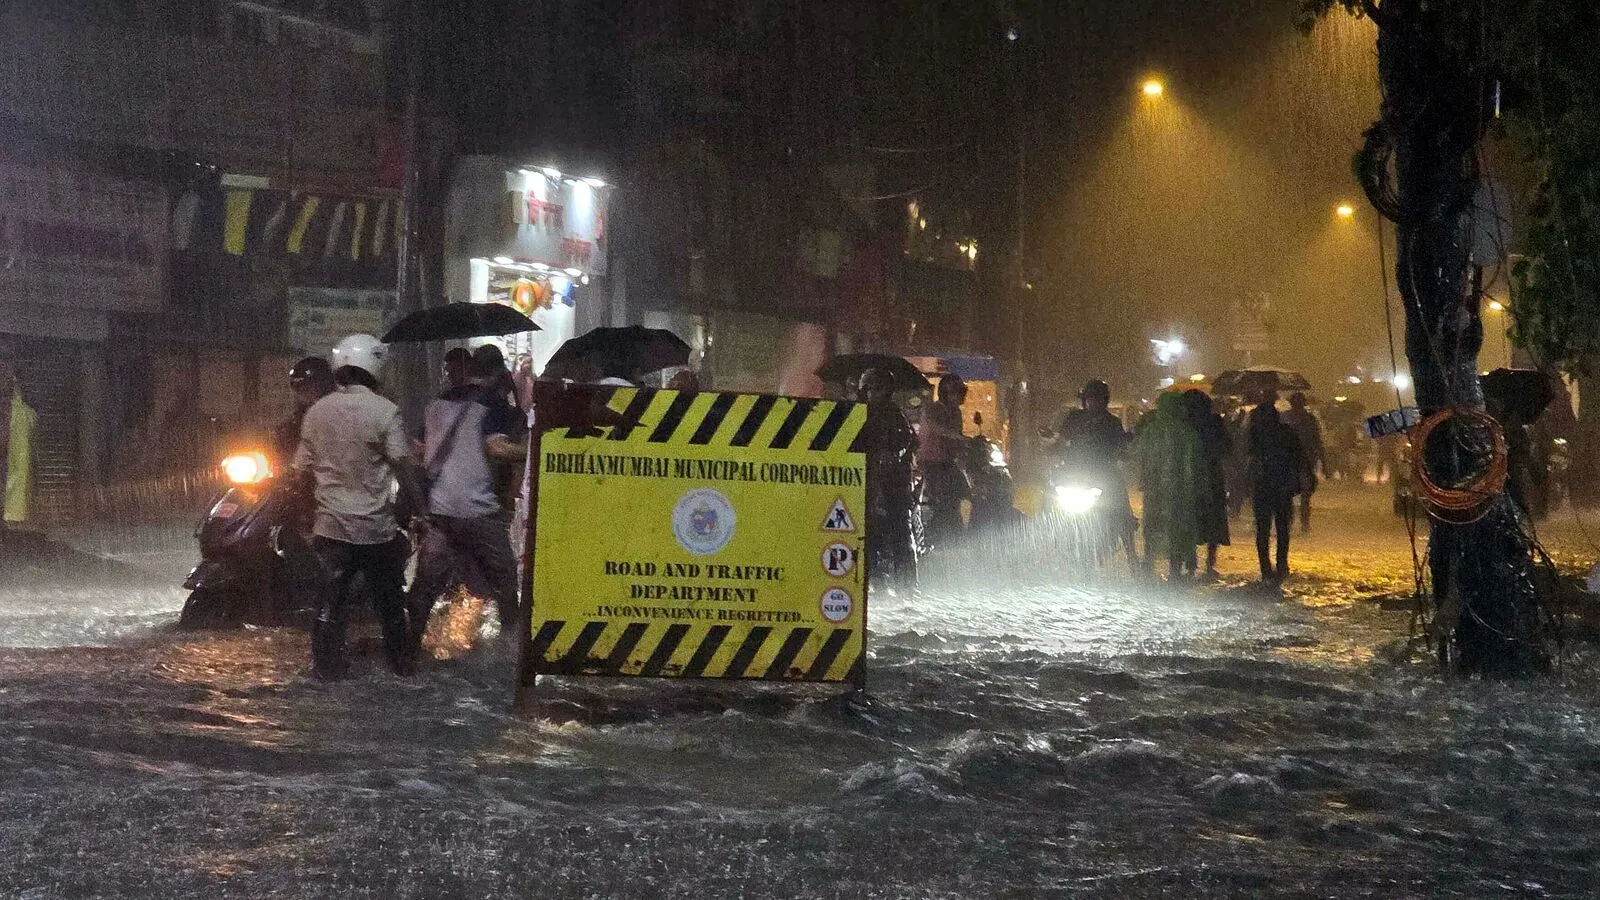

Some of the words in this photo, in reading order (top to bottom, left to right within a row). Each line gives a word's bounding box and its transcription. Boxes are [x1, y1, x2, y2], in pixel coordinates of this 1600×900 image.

[546, 453, 669, 477] BRIHANMUMBAI
[674, 458, 757, 481] MUNICIPAL
[760, 463, 863, 486] CORPORATION
[605, 561, 657, 576] ROAD
[663, 563, 701, 577] AND
[706, 565, 785, 581] TRAFFIC
[630, 584, 758, 602] DEPARTMENT
[830, 593, 844, 601] GO
[823, 604, 849, 613] SLOW
